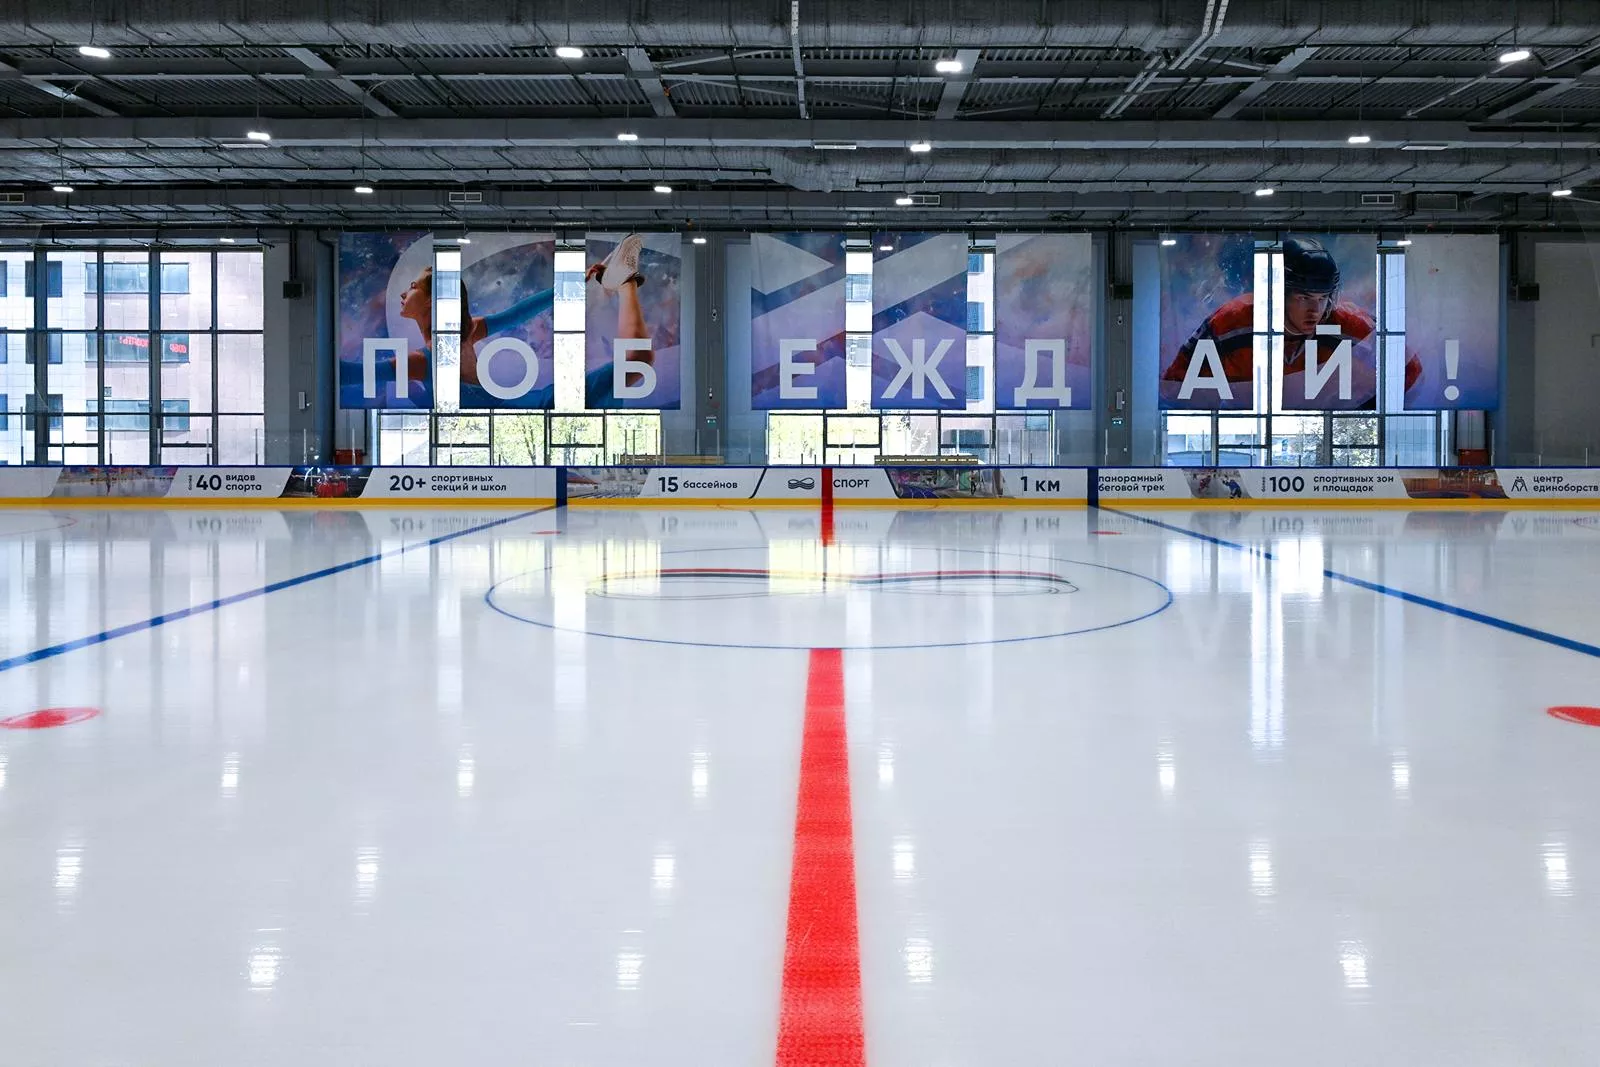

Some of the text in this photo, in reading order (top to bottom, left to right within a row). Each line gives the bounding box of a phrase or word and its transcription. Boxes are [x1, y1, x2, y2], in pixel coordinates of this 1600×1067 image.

[196, 474, 222, 491] 40
[225, 474, 256, 483] видов
[389, 475, 426, 491] 20+
[431, 475, 494, 484] спортивных
[1098, 474, 1163, 484] панорамный
[1313, 476, 1374, 484] спортивных
[1533, 476, 1564, 484] центр
[225, 484, 262, 492] спорта
[431, 483, 470, 492] секций
[658, 476, 738, 493] 15 бассейнов
[832, 479, 870, 488] СПОРТ
[1020, 476, 1028, 492] 1
[1098, 482, 1165, 493] беговой трек
[1269, 476, 1305, 492] 100
[1533, 483, 1599, 493] единоборств
[1322, 485, 1374, 493] площадок
